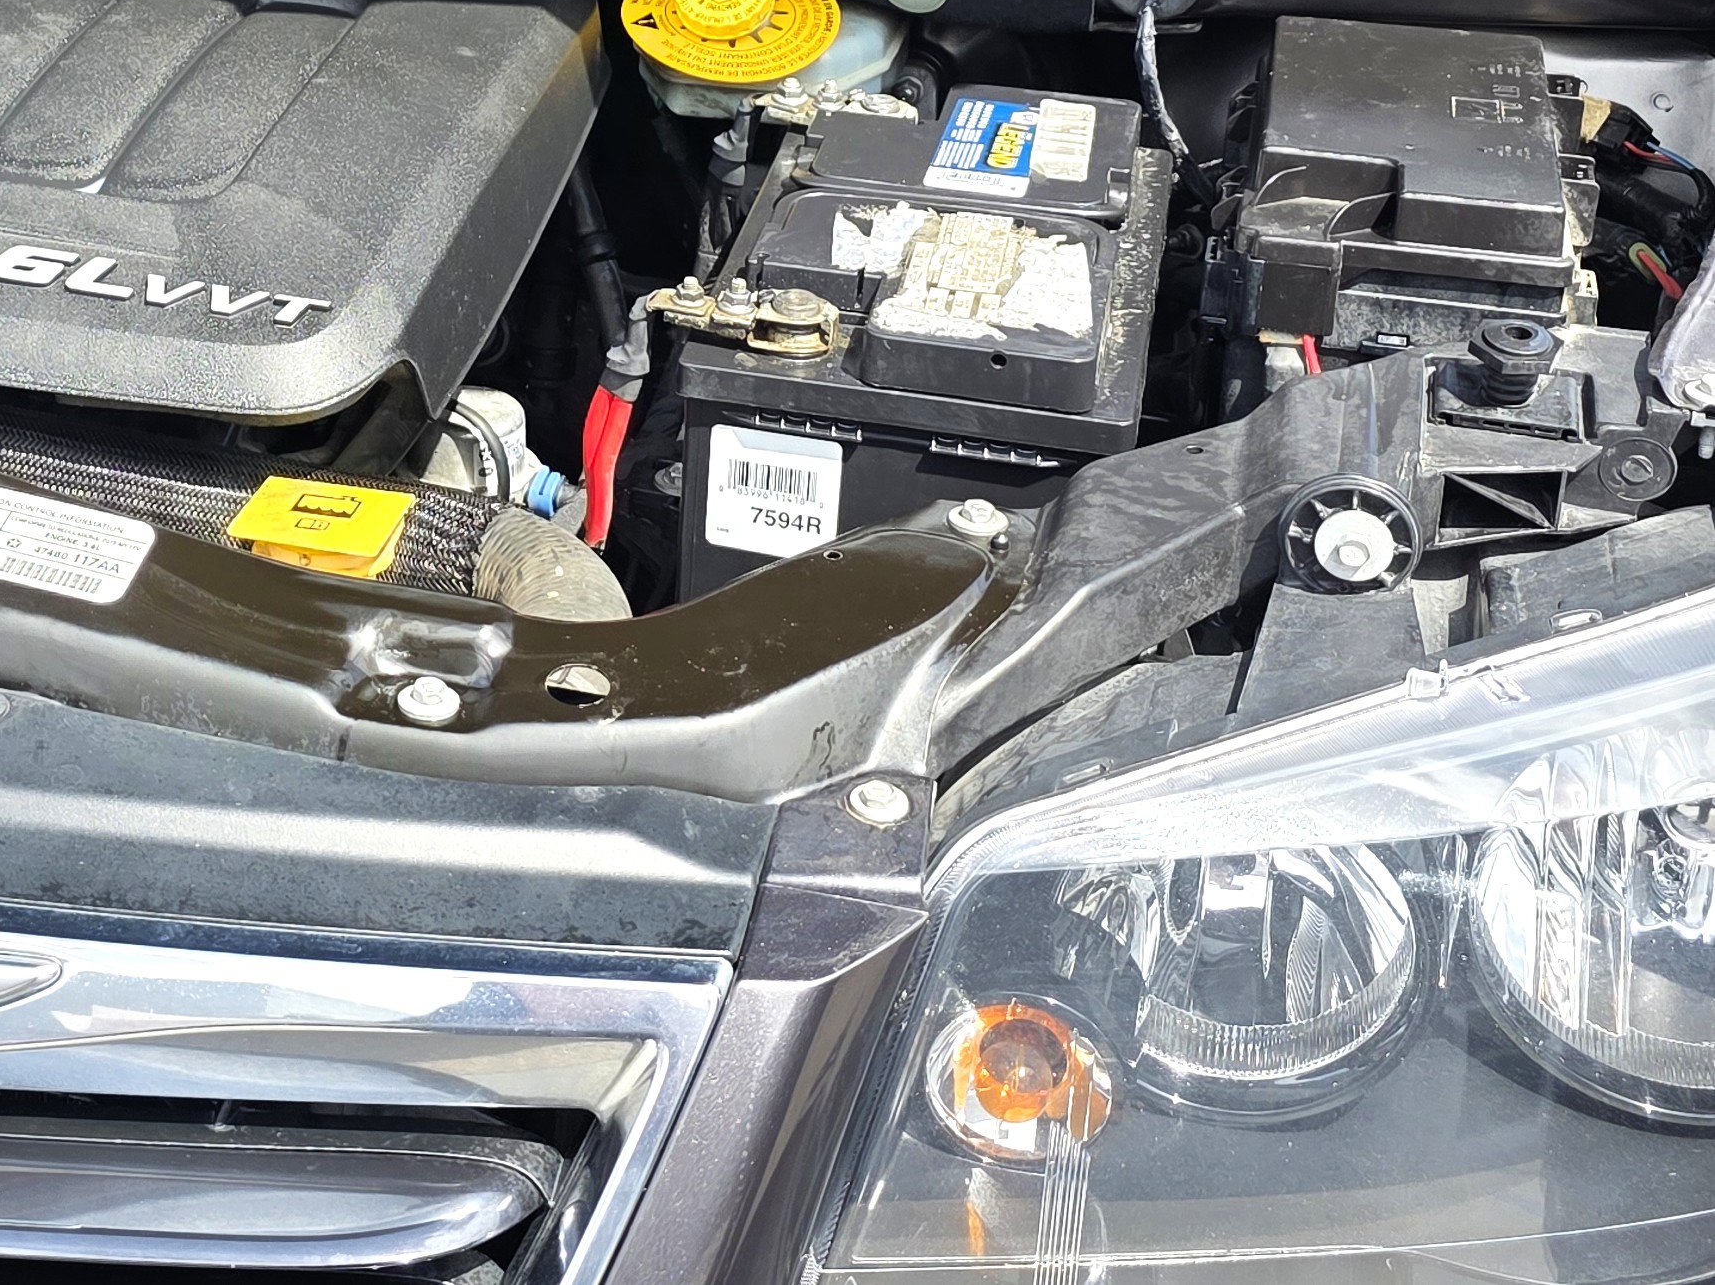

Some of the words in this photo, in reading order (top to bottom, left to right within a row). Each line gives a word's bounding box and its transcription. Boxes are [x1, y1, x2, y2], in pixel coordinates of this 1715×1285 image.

[13, 500, 58, 518] CONTROL
[59, 510, 125, 534] INFORMATION
[750, 506, 822, 535] 7594R
